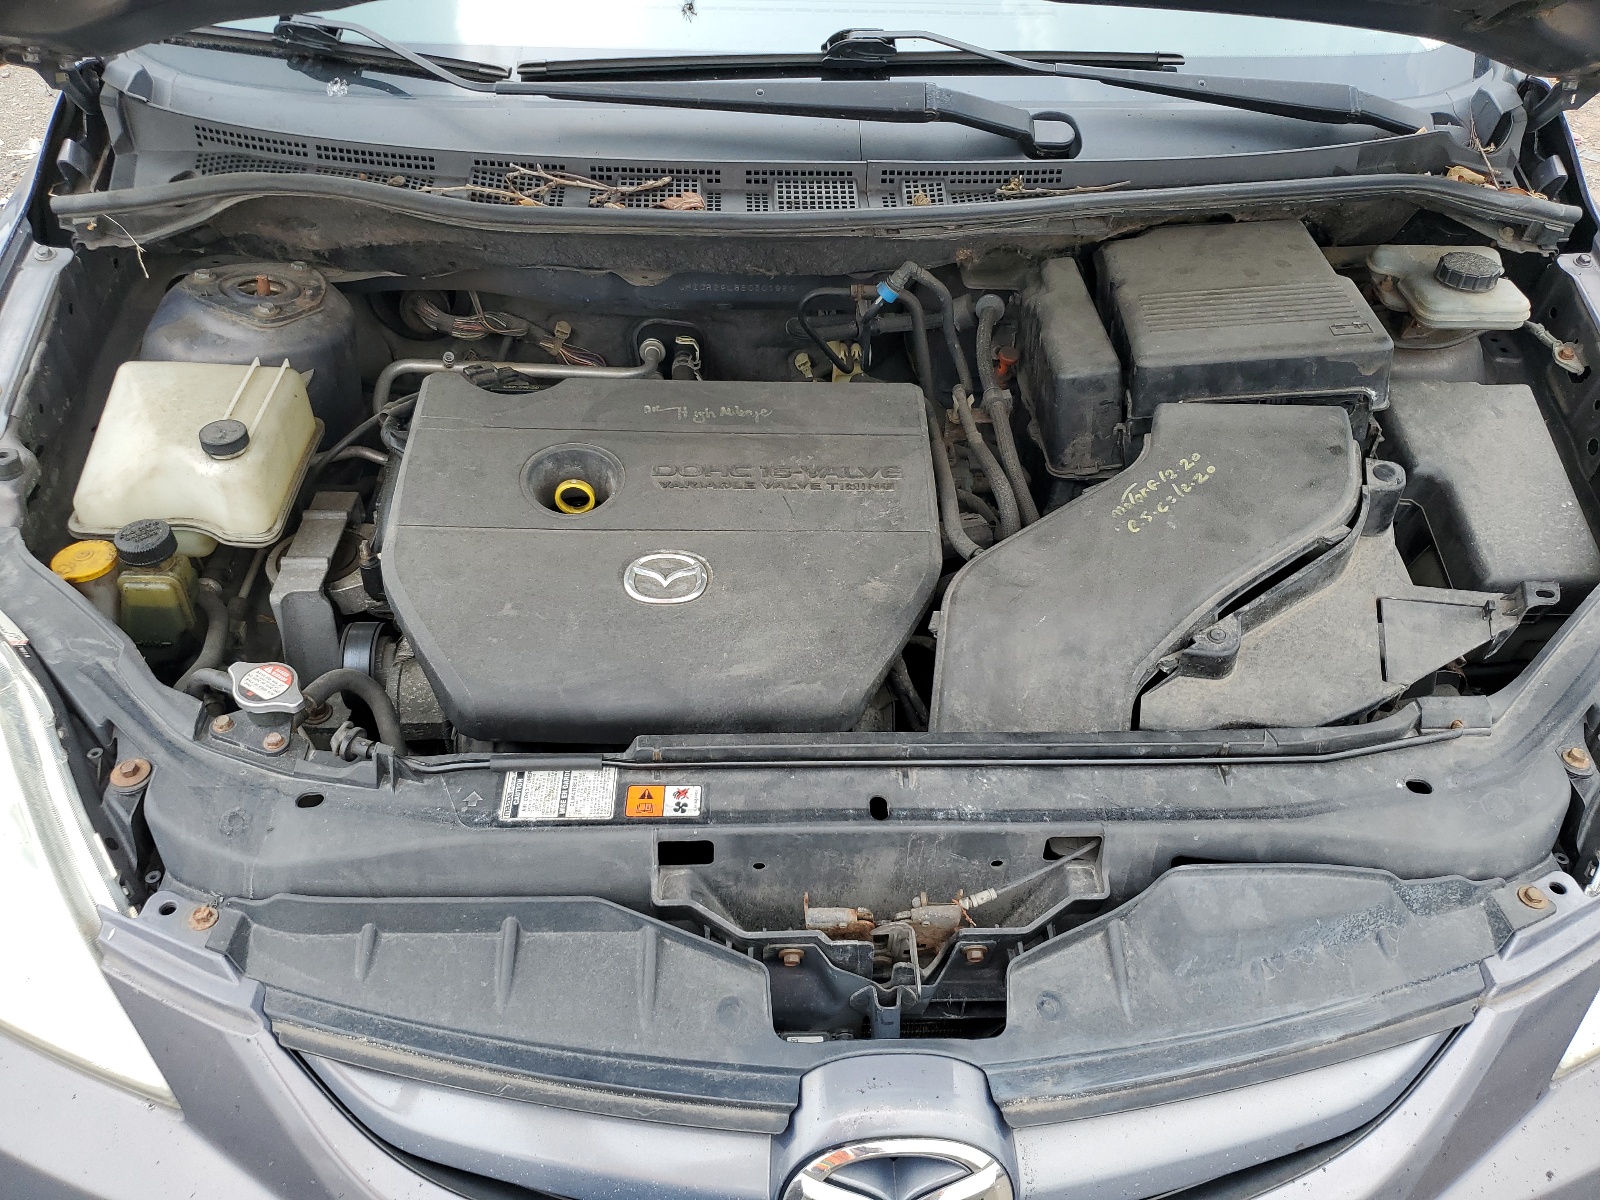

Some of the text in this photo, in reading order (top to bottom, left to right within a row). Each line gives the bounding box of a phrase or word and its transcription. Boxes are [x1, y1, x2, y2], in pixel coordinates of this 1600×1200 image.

[652, 465, 753, 478] DOHC
[658, 481, 896, 492] VARIABLE VALVE TIMING
[513, 778, 524, 805] CAUTION
[561, 790, 569, 799] EN
[558, 799, 567, 815] MISE
